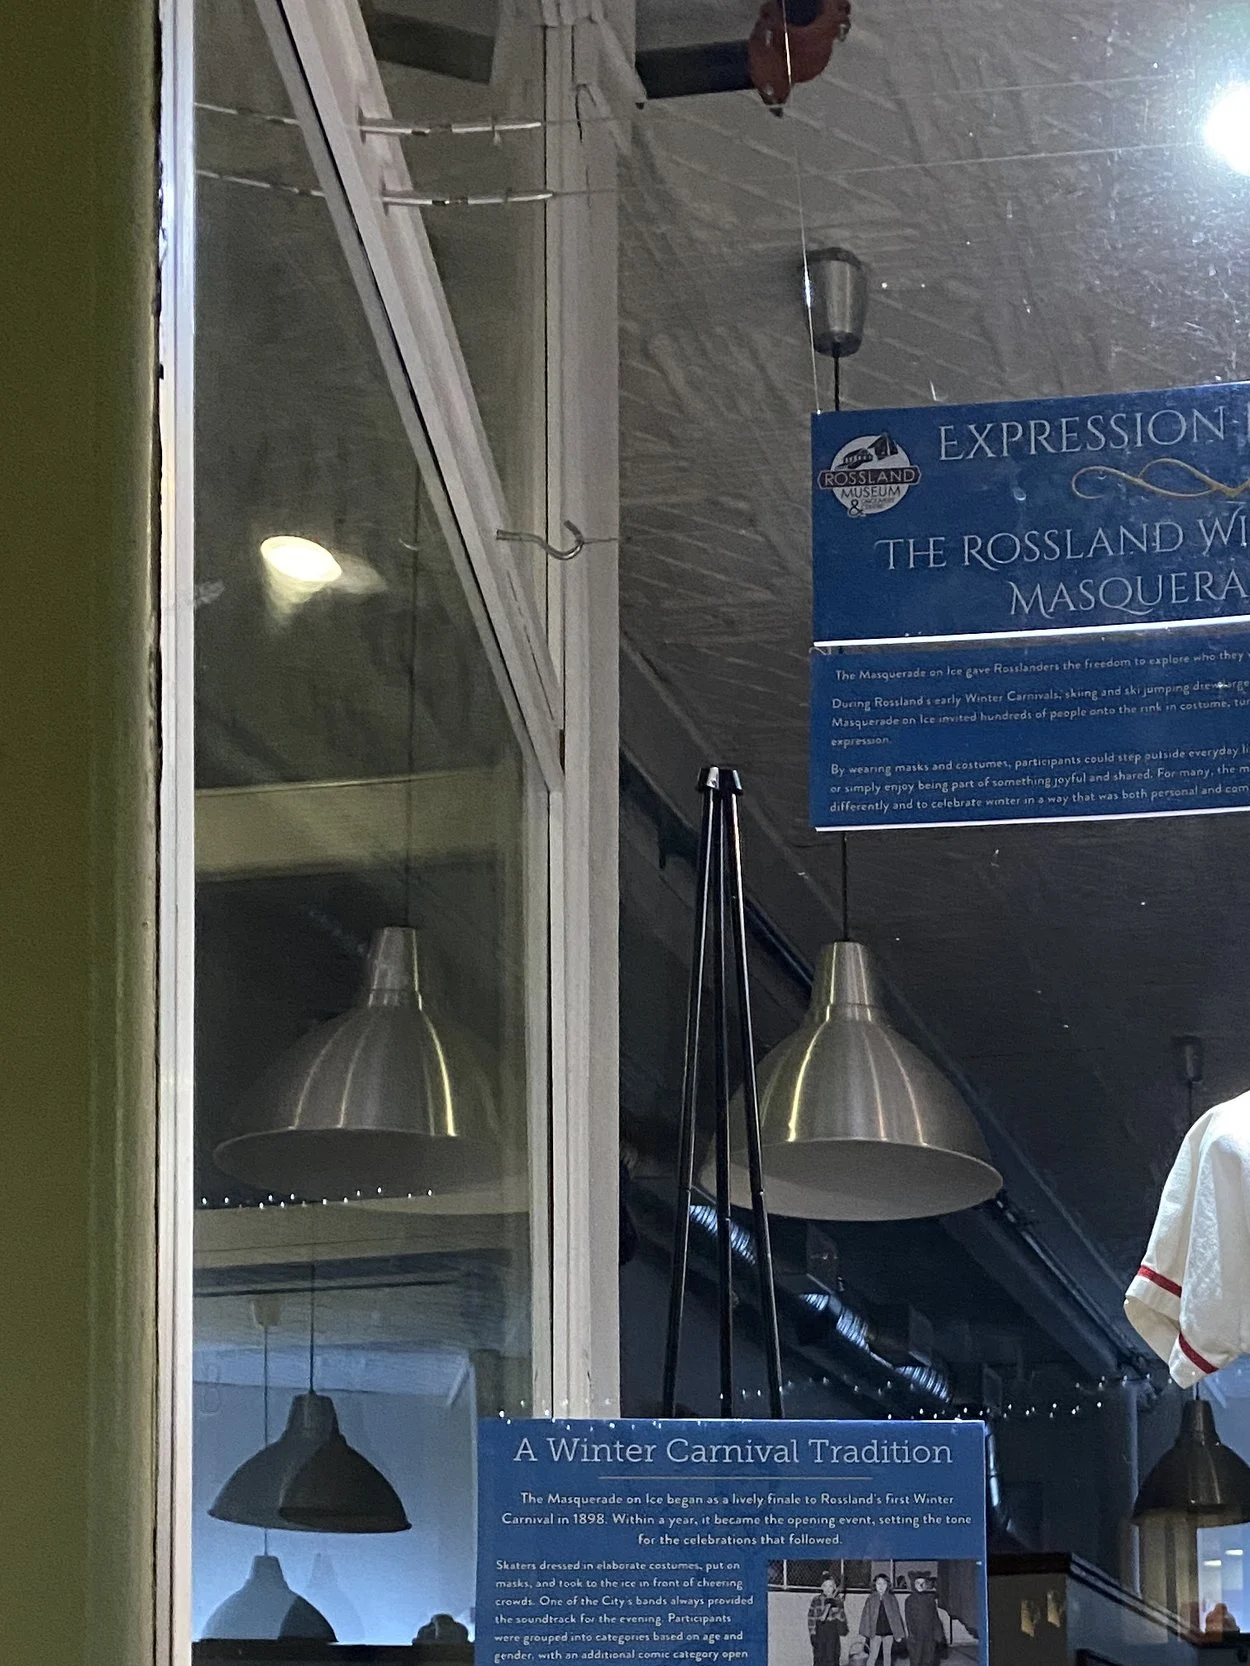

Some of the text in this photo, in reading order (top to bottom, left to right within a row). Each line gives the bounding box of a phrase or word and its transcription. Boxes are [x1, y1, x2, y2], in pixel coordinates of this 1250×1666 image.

[939, 405, 1227, 461] EXPRESSION
[824, 468, 916, 486] ROSSLAND
[840, 485, 901, 499] MUSEUM
[848, 499, 864, 516] &
[874, 536, 946, 569] THE
[961, 521, 1183, 570] ROSSLAND
[829, 800, 889, 812] differently
[892, 798, 913, 809] and
[915, 799, 928, 809] to
[930, 796, 982, 808] celebrate
[985, 796, 1020, 805] winter
[1023, 796, 1035, 805] in
[1037, 796, 1044, 804] a
[1047, 795, 1068, 804] way
[1071, 791, 1095, 802] that
[1098, 792, 1119, 800] was
[1121, 788, 1147, 799] both
[1150, 784, 1198, 799] personal
[1200, 782, 1222, 794] and
[512, 1437, 953, 1463] A Winter Carnival Tradition
[519, 1491, 953, 1508] The Masquerade on Ice began as a lively finale to Rossland's first Winter
[501, 1512, 553, 1524] Carnival
[557, 1513, 569, 1524] in
[611, 1512, 654, 1524] Within
[658, 1516, 665, 1524] a
[701, 1515, 710, 1524] it
[713, 1513, 760, 1524] became
[763, 1513, 784, 1524] the
[787, 1516, 836, 1528] opening
[878, 1515, 919, 1528] setting
[922, 1512, 942, 1524] the
[945, 1515, 971, 1524] tone
[637, 1532, 655, 1545] for
[659, 1533, 679, 1544] the
[683, 1533, 757, 1545] celebrations
[760, 1533, 785, 1544] that
[495, 1559, 536, 1570] Skaters
[538, 1560, 580, 1570] dressed
[595, 1560, 646, 1572] elaborate
[705, 1562, 724, 1573] put
[535, 1577, 556, 1587] and
[558, 1577, 583, 1587] took
[585, 1579, 597, 1587] to
[599, 1577, 618, 1587] the
[652, 1576, 679, 1587] front
[682, 1576, 695, 1587] of
[696, 1577, 743, 1590] cheering
[538, 1595, 563, 1605] One
[565, 1595, 578, 1605] of
[580, 1595, 599, 1605] the
[635, 1595, 667, 1605] bands
[669, 1595, 704, 1608] always
[707, 1594, 753, 1608] provided
[494, 1613, 513, 1624] the
[515, 1613, 576, 1623] soundtrack
[579, 1612, 595, 1623] for
[598, 1612, 616, 1623] the
[667, 1612, 731, 1625] Participants
